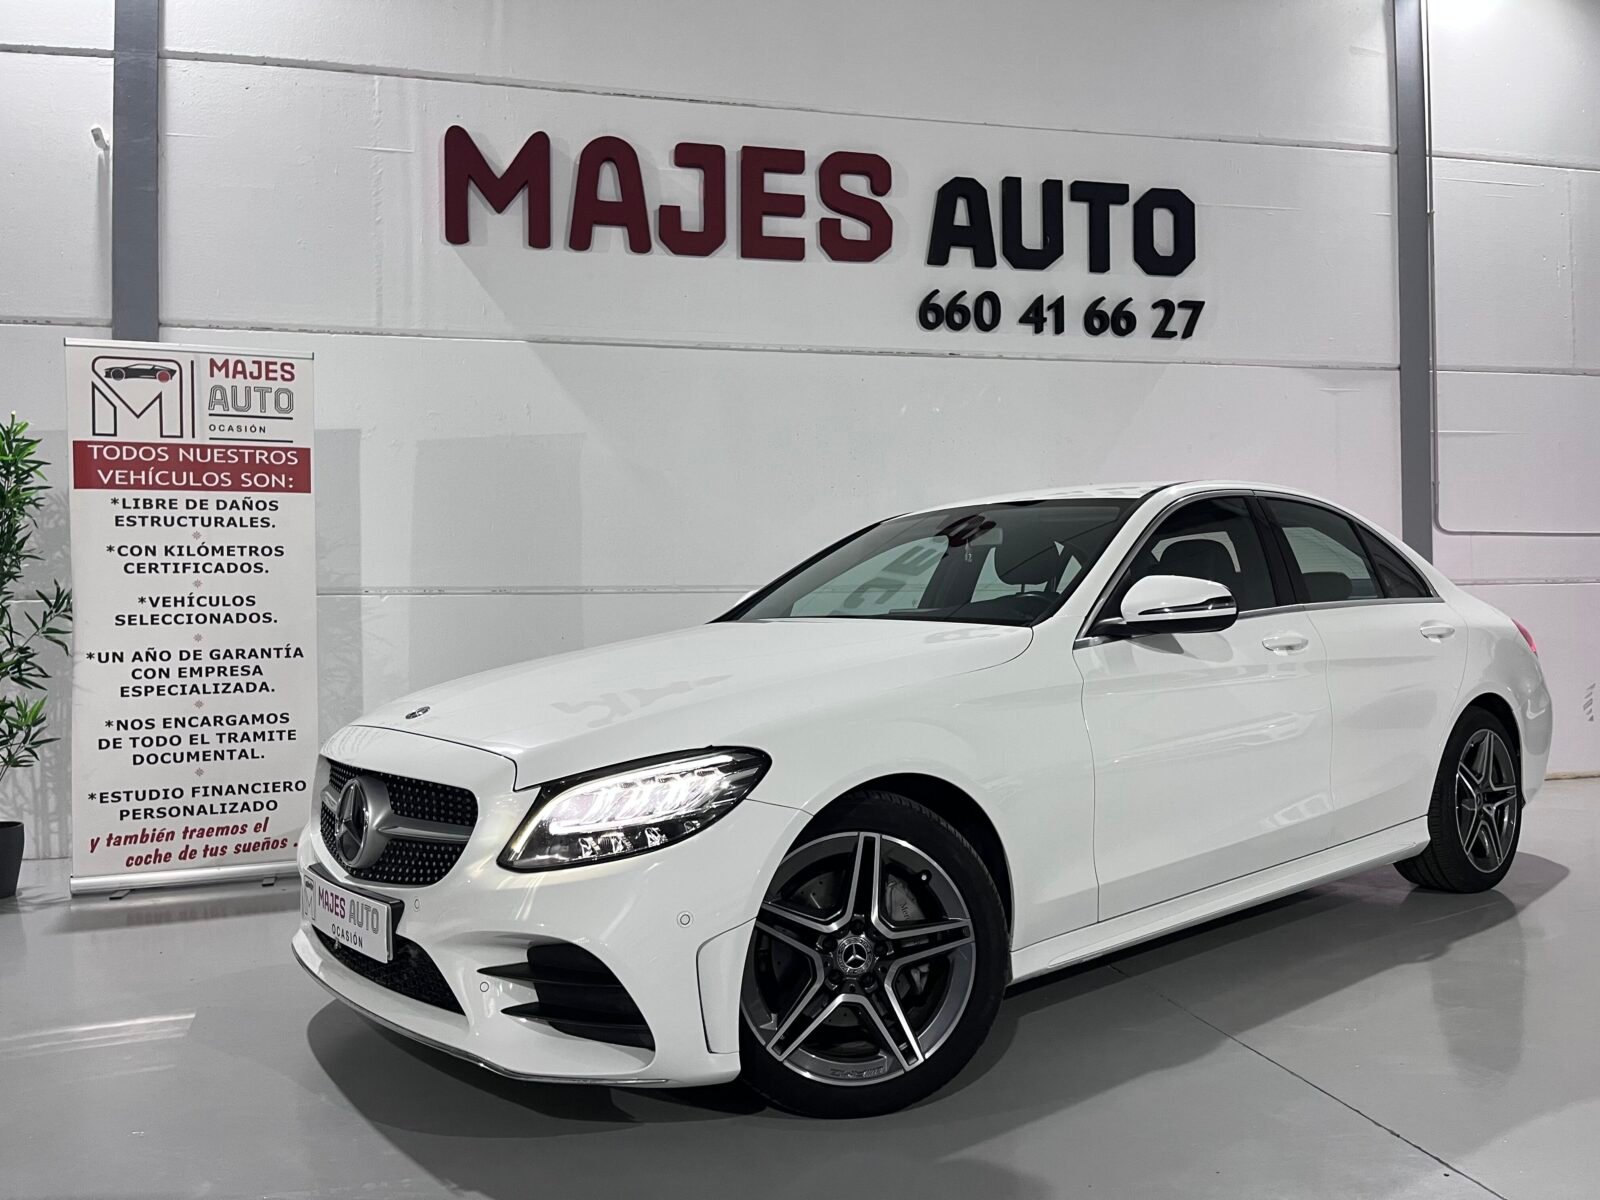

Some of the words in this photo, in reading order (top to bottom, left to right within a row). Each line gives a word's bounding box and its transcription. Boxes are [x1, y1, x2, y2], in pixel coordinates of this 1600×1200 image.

[443, 124, 893, 263] MAJES
[926, 176, 1196, 277] AUTO
[918, 288, 1001, 333] 660
[1018, 294, 1066, 336] 41
[1083, 296, 1137, 338] 66
[1151, 298, 1205, 340] 27
[209, 357, 295, 382] MAJES
[208, 384, 294, 414] AUTO
[208, 423, 266, 434] OCASIÓN
[87, 444, 169, 462] TODOS
[178, 447, 298, 465] NUESTROS
[97, 466, 232, 487] VEHÍCULOS
[240, 472, 294, 488] SON:
[185, 498, 209, 510] DE
[215, 496, 279, 512] DAÑOS
[114, 515, 276, 529] ESTRUCTURALES.
[164, 541, 285, 557] KILÓMETROS
[123, 562, 269, 574] CERTIFICADOS.
[114, 612, 278, 626] SELECCIONADOS.
[131, 647, 172, 663] AÑO
[178, 649, 202, 661] DE
[209, 643, 304, 661] GARANTÍA
[131, 667, 171, 680] CON
[177, 664, 263, 679] EMPRESA
[119, 681, 275, 697] ESPECIALIZADA.
[162, 712, 290, 729] ENCARGAMOS
[98, 737, 122, 750] DE
[129, 734, 182, 749] TODO
[189, 733, 210, 745] EL
[215, 729, 297, 745] TRAMITE
[132, 748, 265, 765] DOCUMENTAL.
[191, 779, 307, 798] FINANCIERO
[119, 799, 278, 821] PERSONALIZADO
[89, 836, 99, 853] y
[106, 826, 176, 848] también
[181, 822, 248, 840] traemos
[253, 816, 269, 833] el
[125, 848, 172, 868] coche
[178, 844, 197, 861] de
[202, 843, 228, 858] tus
[233, 837, 288, 854] sueños
[318, 886, 346, 919] MAJES
[348, 899, 379, 934] AUTO
[331, 923, 363, 948] OCASIÓN
